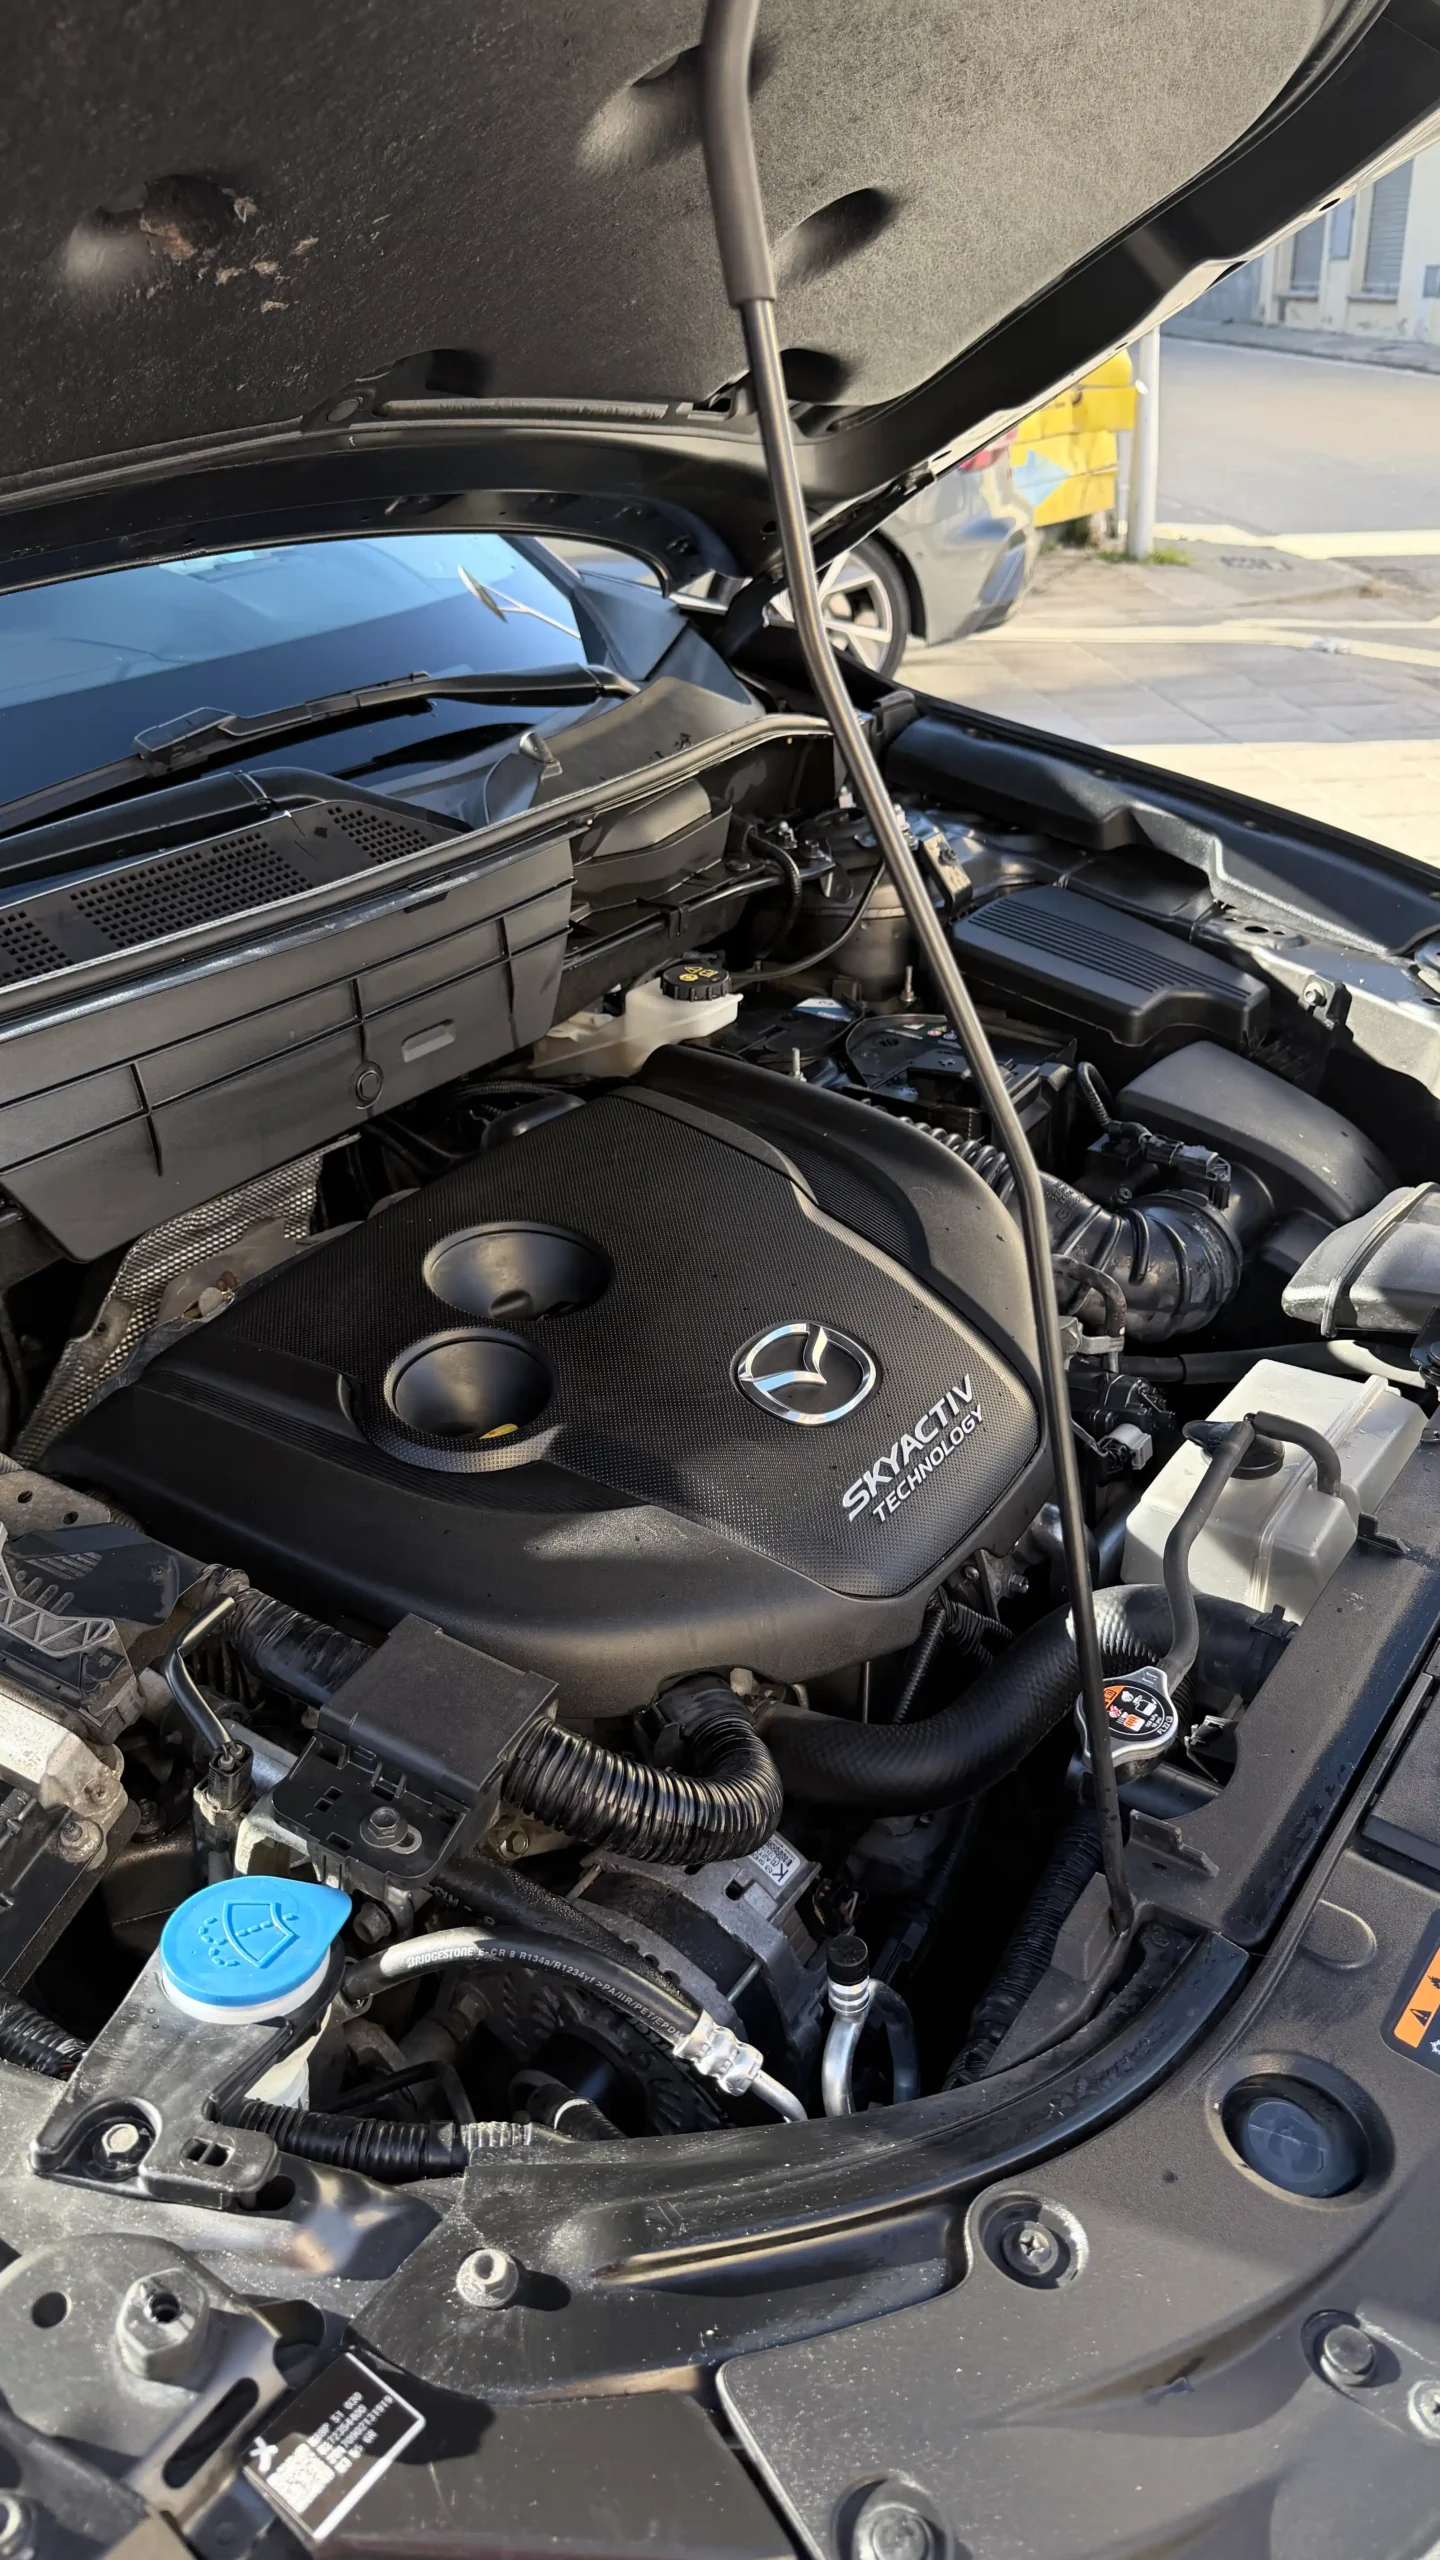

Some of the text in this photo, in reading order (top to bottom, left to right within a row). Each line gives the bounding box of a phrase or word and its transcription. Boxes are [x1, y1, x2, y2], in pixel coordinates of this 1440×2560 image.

[842, 1373, 973, 1522] SKYACTIV
[872, 1404, 983, 1522] TECHNOLOGY
[772, 1863, 789, 1882] K
[406, 1946, 474, 1969] BRIDGESTONE
